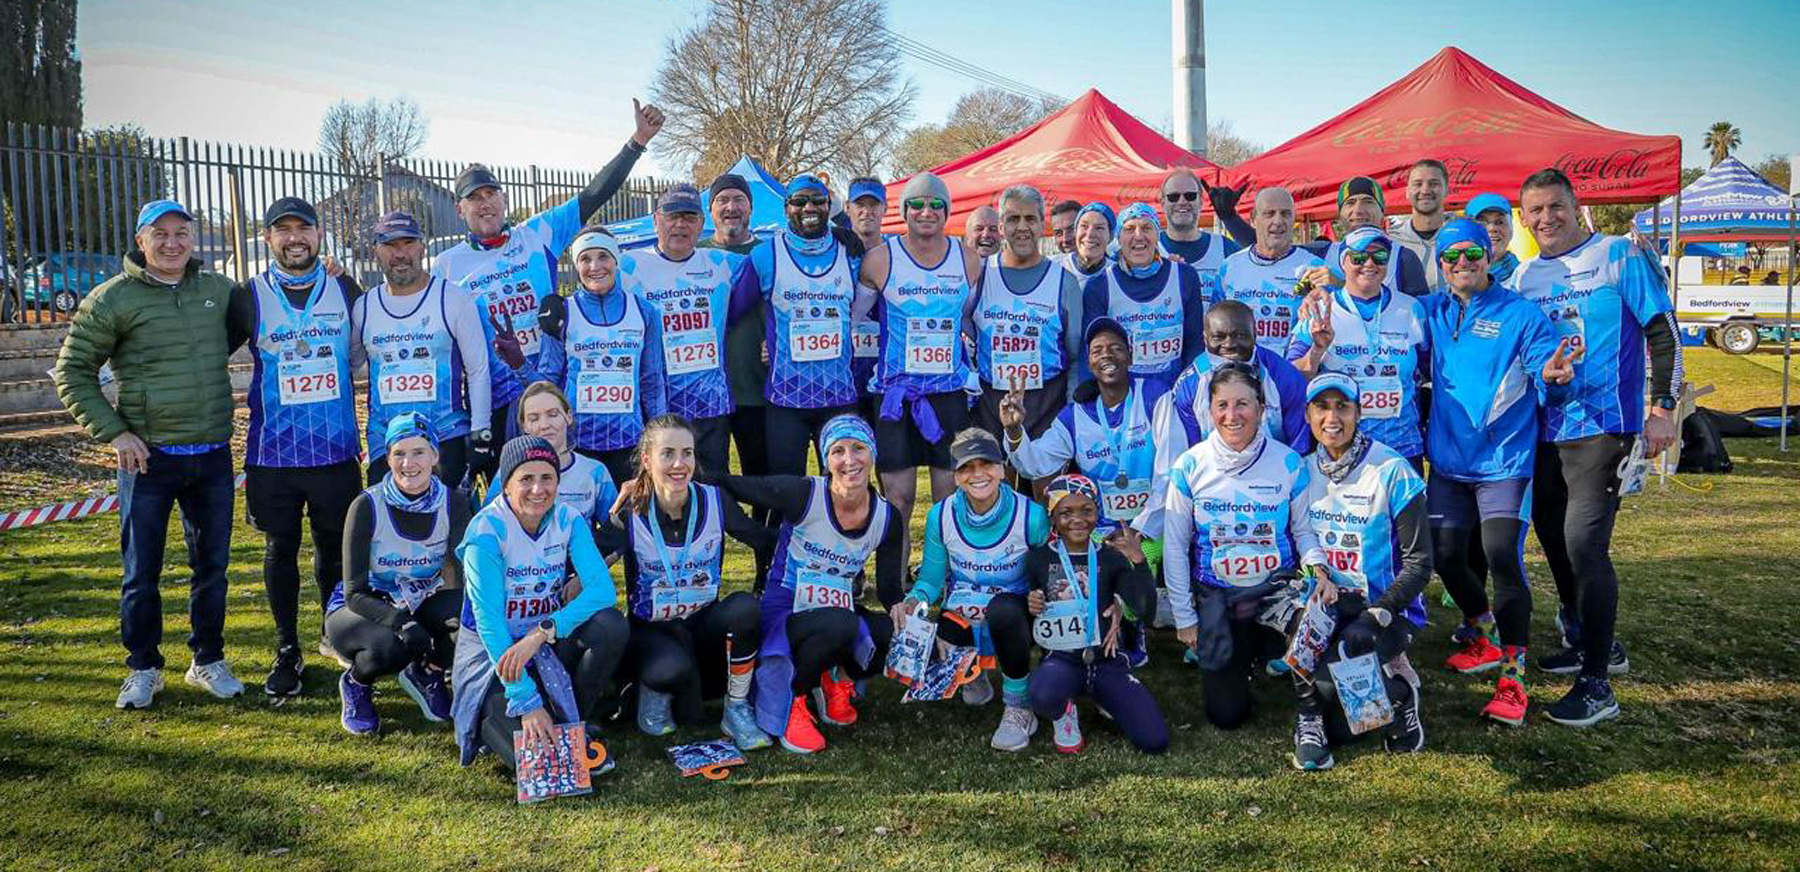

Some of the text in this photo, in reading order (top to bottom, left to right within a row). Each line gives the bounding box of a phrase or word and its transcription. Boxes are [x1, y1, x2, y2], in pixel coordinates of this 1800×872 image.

[646, 285, 715, 301] Bedfordview
[783, 289, 845, 301] Bedfordview
[897, 285, 961, 296] Bedfordview
[1689, 299, 1751, 309] Bedfordview
[662, 311, 710, 332] P3097
[983, 309, 1050, 326] Bedfordview
[1256, 320, 1289, 338] 9199
[372, 332, 434, 345] Bedfordview
[574, 340, 640, 353] Bedfordview
[796, 332, 840, 352] 1364
[1140, 337, 1181, 357] 1193
[673, 342, 716, 363] 1273
[996, 363, 1040, 381] 1269
[286, 372, 337, 394] 1278
[384, 373, 434, 393] 1329
[584, 385, 633, 404] 1290
[1361, 392, 1400, 409] 285
[1203, 501, 1280, 513] Bedfordview
[1309, 510, 1369, 525] edfordview
[1220, 555, 1278, 576] 1210
[806, 585, 851, 611] 1330
[1039, 616, 1087, 638] 314
